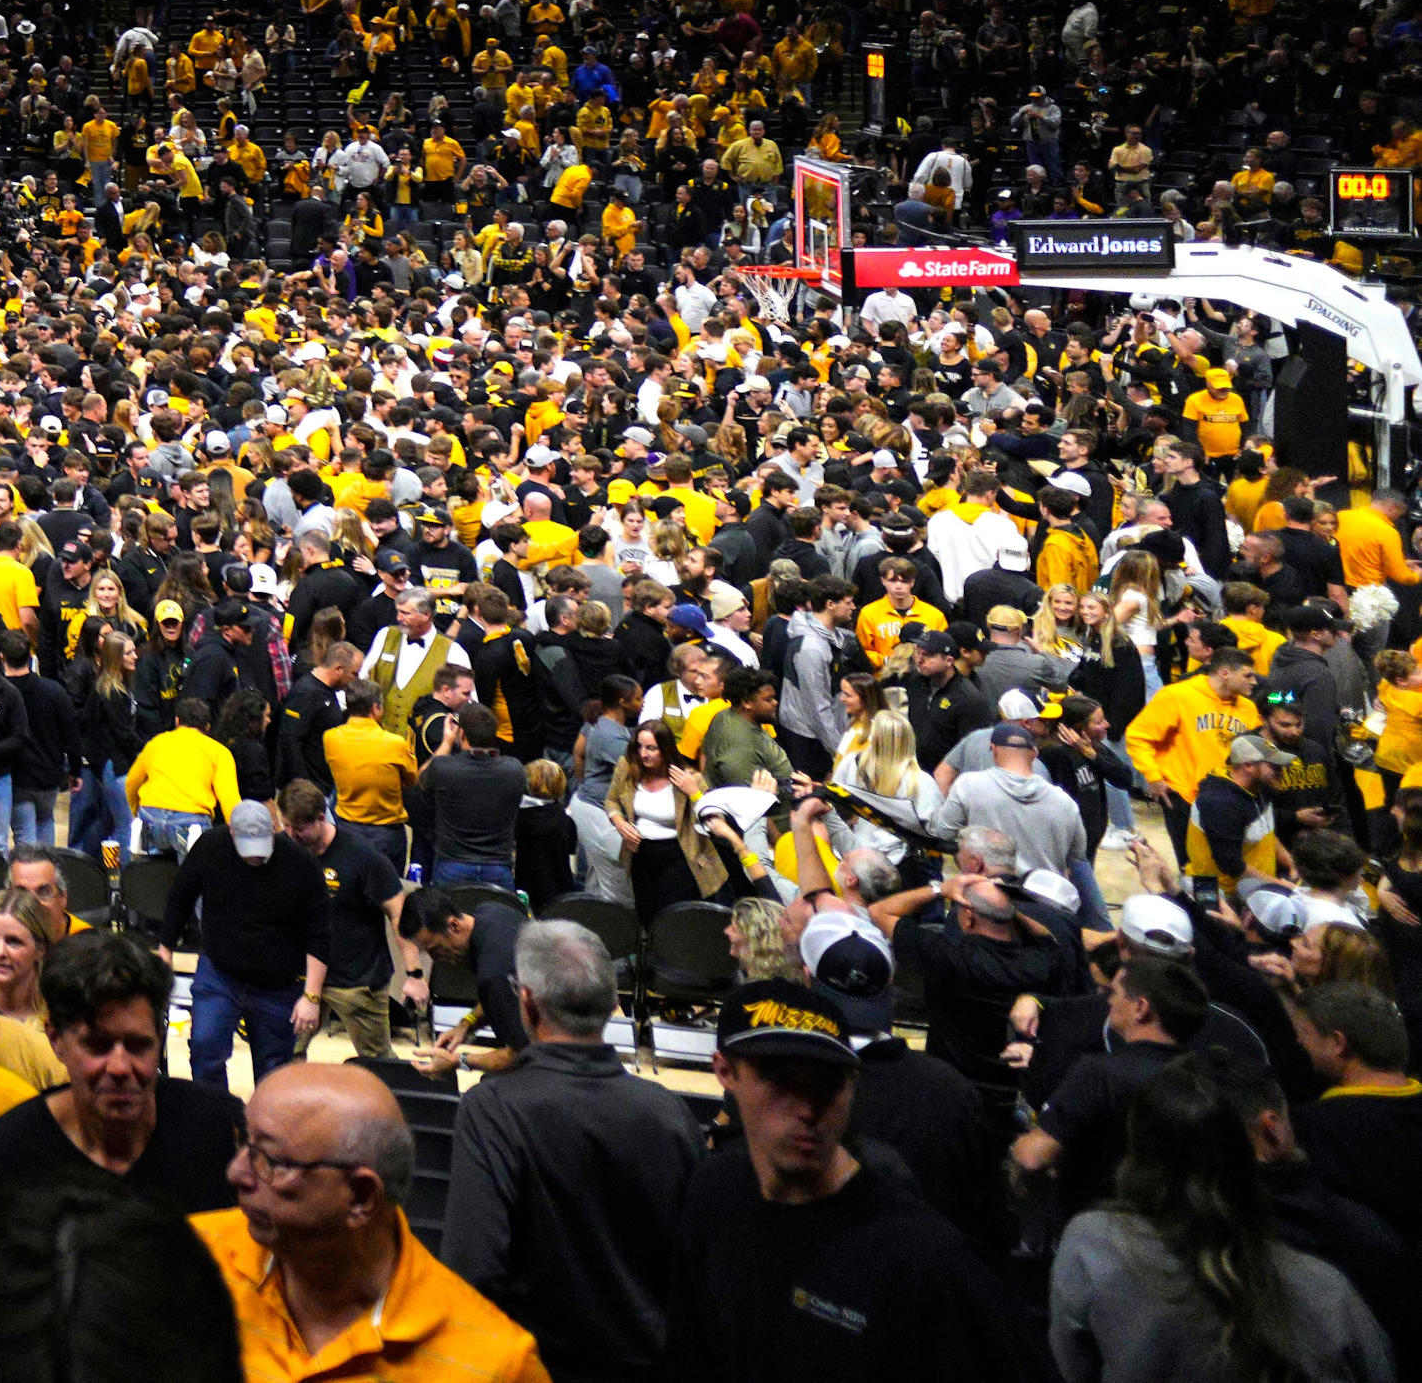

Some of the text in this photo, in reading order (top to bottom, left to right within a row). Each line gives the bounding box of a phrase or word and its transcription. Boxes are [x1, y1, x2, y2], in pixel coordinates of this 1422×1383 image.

[1338, 174, 1389, 199] 00.0
[1304, 298, 1362, 338] SPALDING
[140, 476, 153, 488] M
[877, 621, 901, 639] TIG
